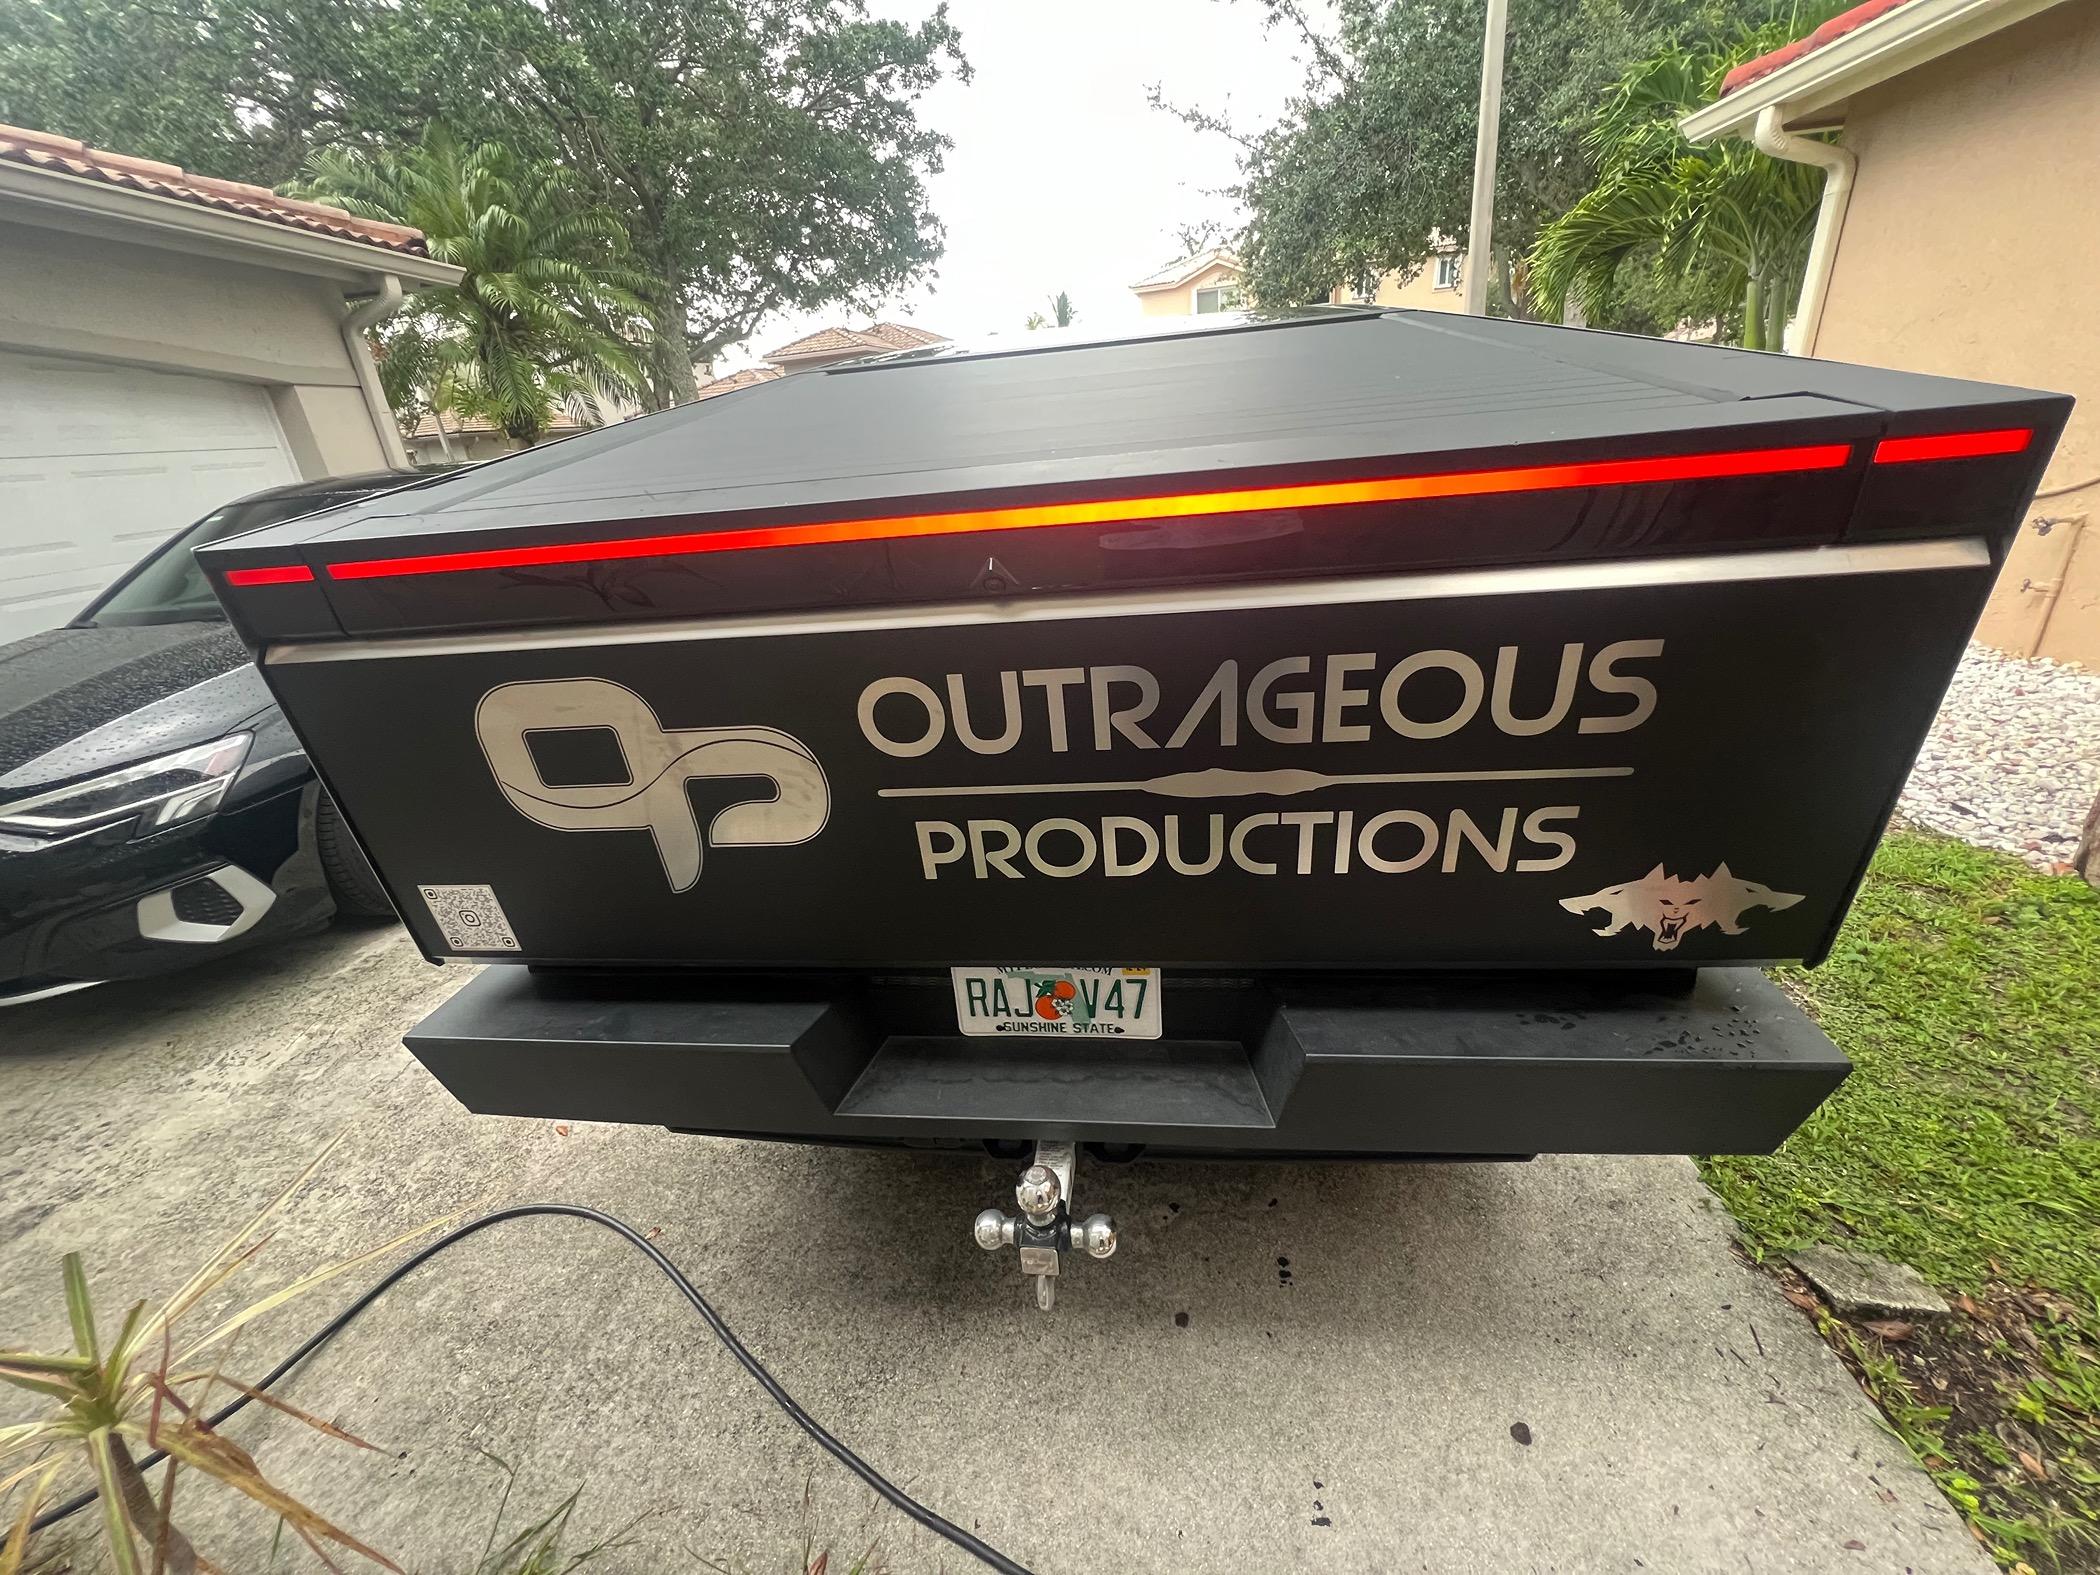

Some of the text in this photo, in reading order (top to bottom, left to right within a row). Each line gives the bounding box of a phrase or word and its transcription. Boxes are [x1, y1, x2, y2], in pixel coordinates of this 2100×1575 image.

[856, 639, 1665, 758] OUTRAGEOUS
[914, 805, 1582, 881] PRODUCTIONS
[965, 977, 1148, 1019] RAJ V47
[1003, 1021, 1114, 1034] SUNSHINE STATE
